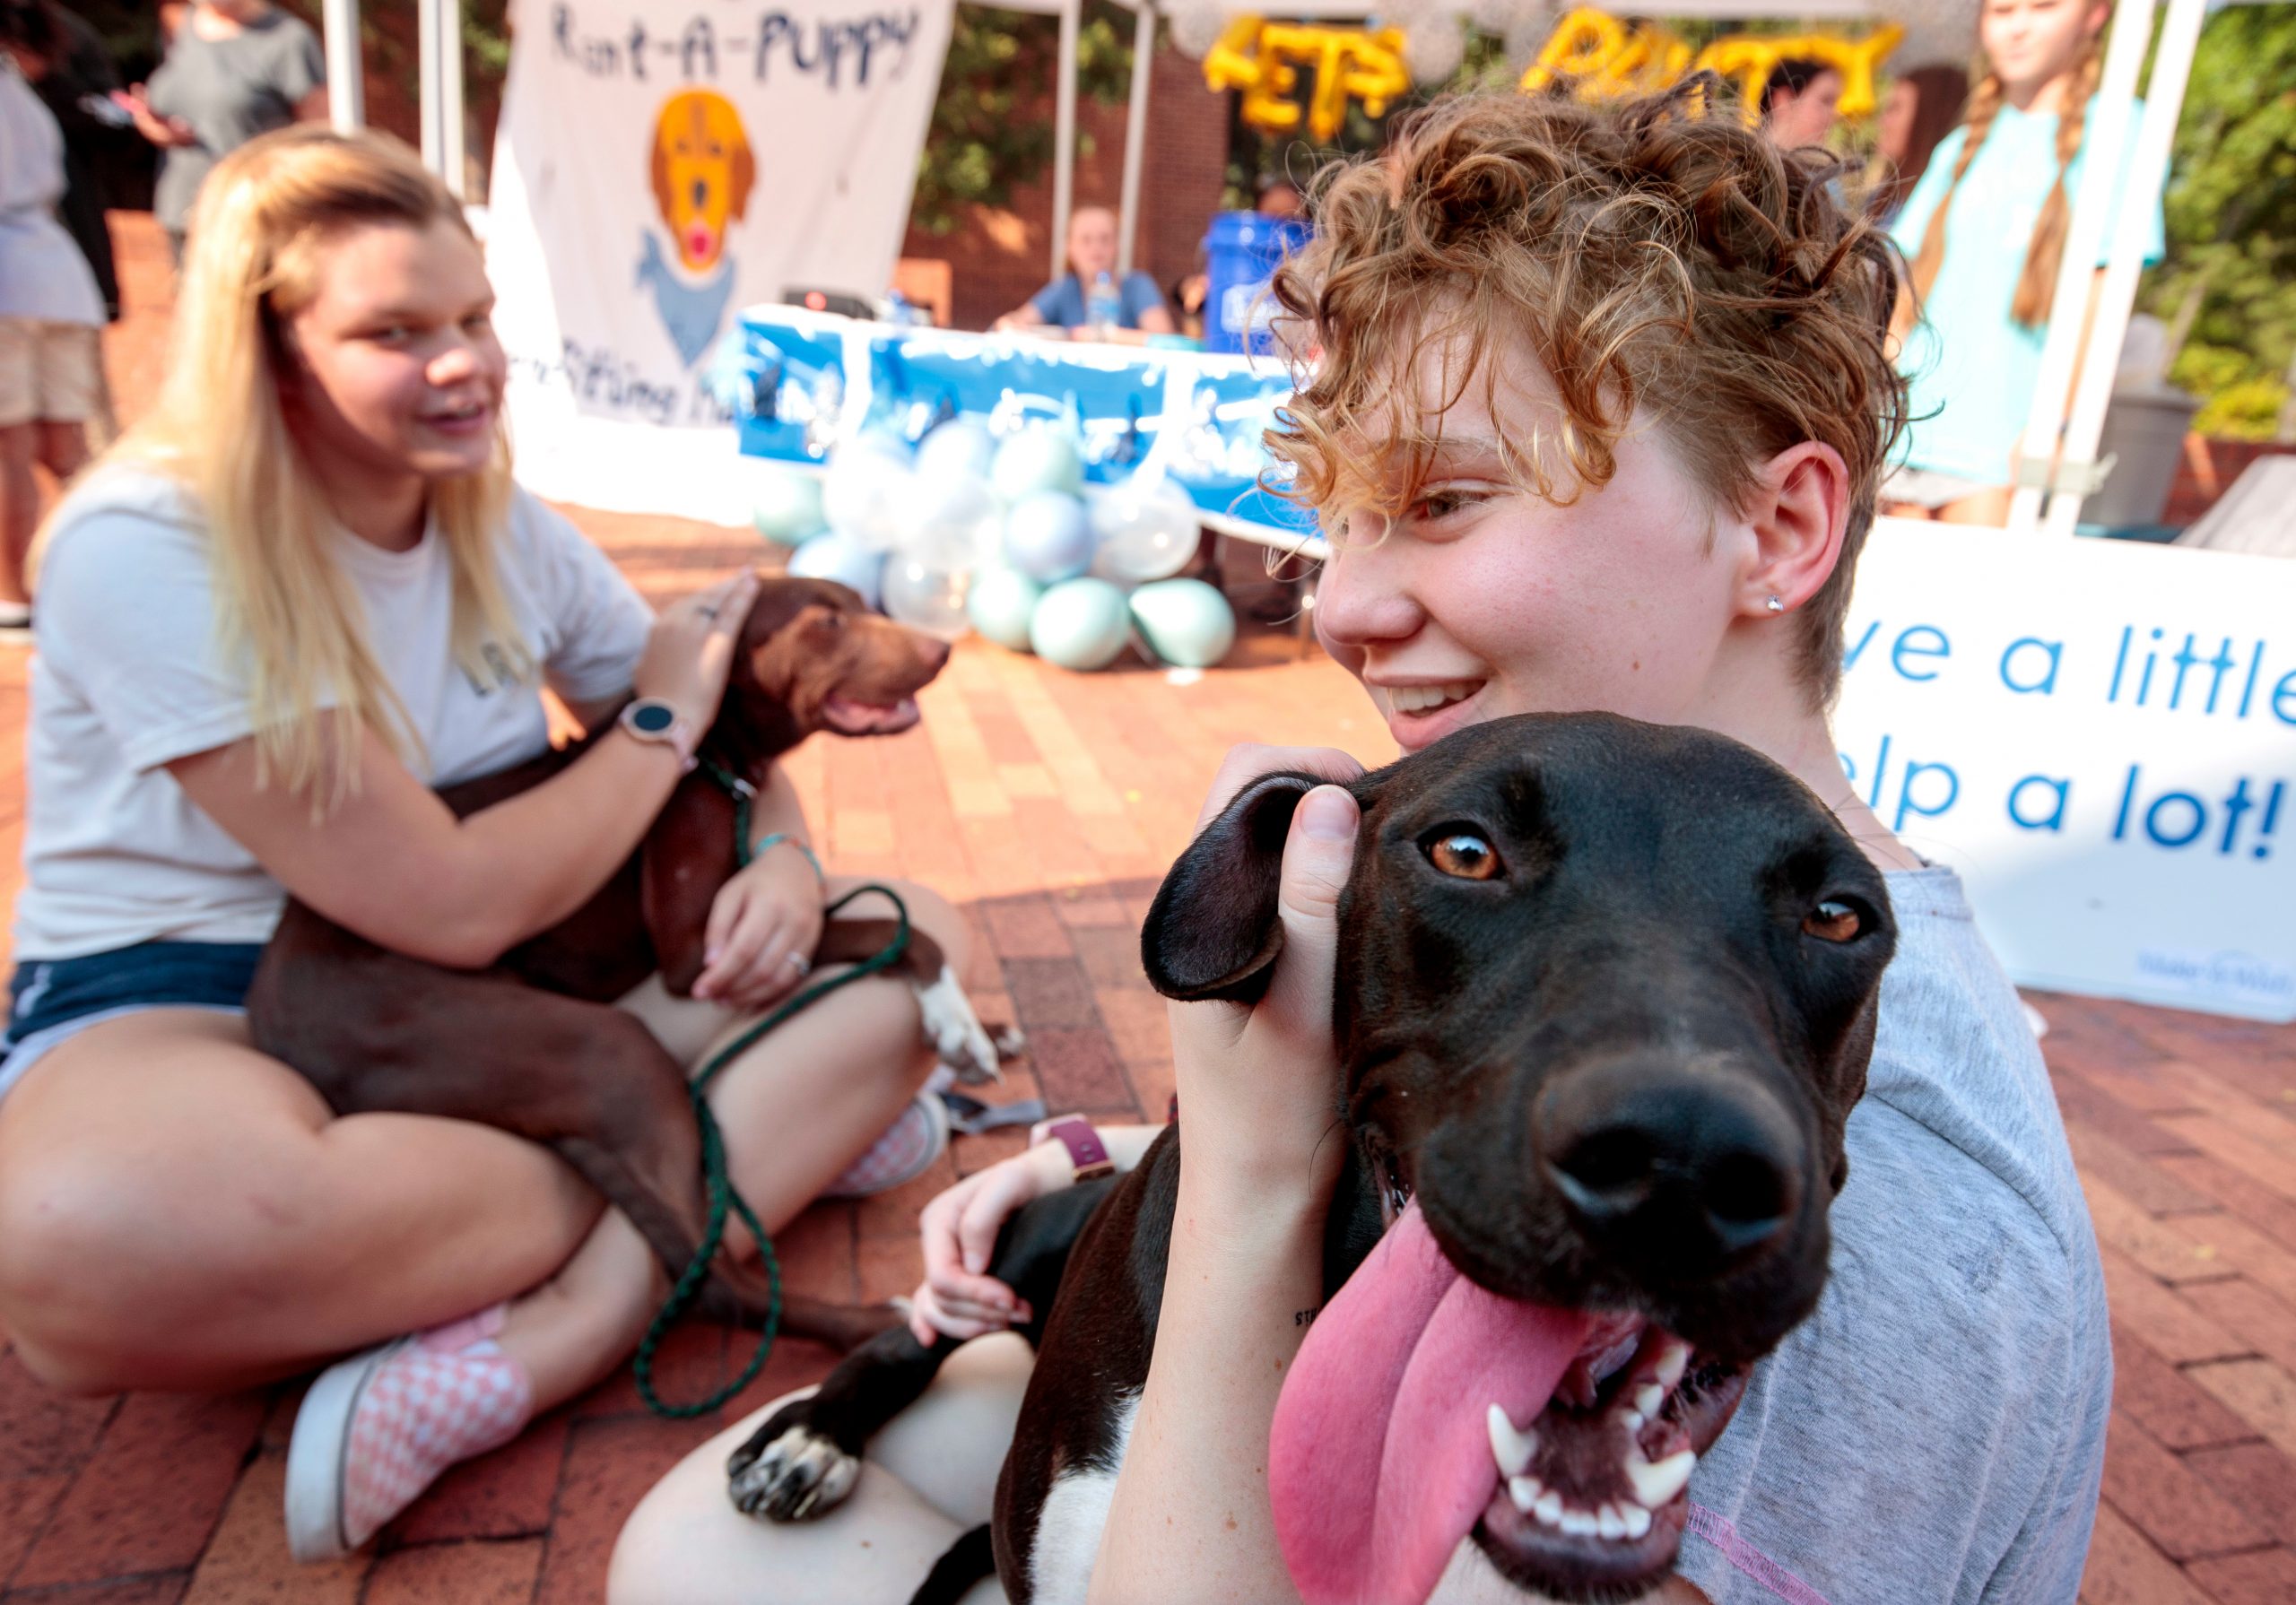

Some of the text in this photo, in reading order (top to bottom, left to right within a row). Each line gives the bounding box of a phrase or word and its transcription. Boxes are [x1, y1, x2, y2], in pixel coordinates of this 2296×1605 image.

[1999, 637, 2063, 695] a
[2006, 775, 2071, 832] a
[2111, 763, 2286, 860] lot!
